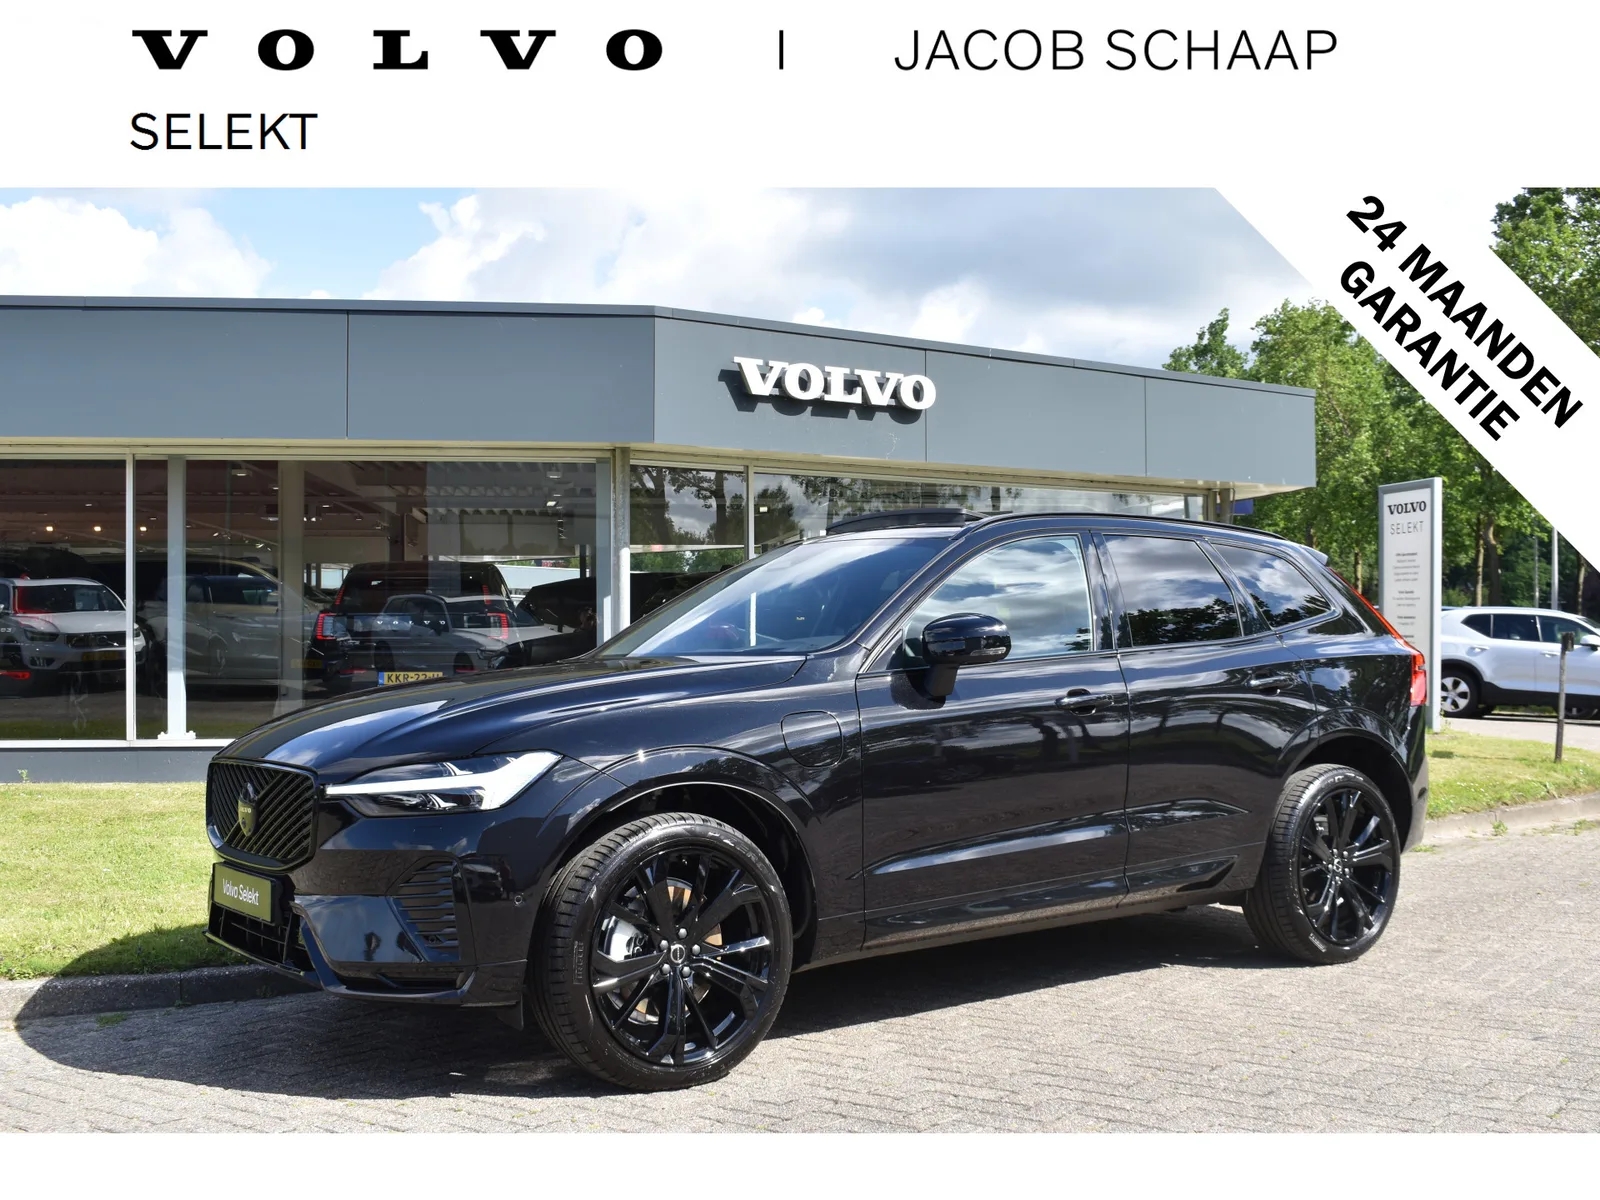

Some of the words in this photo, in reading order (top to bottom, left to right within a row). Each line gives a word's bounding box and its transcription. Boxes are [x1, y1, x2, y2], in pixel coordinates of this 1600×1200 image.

[733, 356, 937, 411] VOLVO
[1387, 500, 1427, 515] VOLVO
[1390, 520, 1424, 535] SELEKT
[222, 878, 239, 899] Volvo
[239, 884, 259, 906] Selekt
